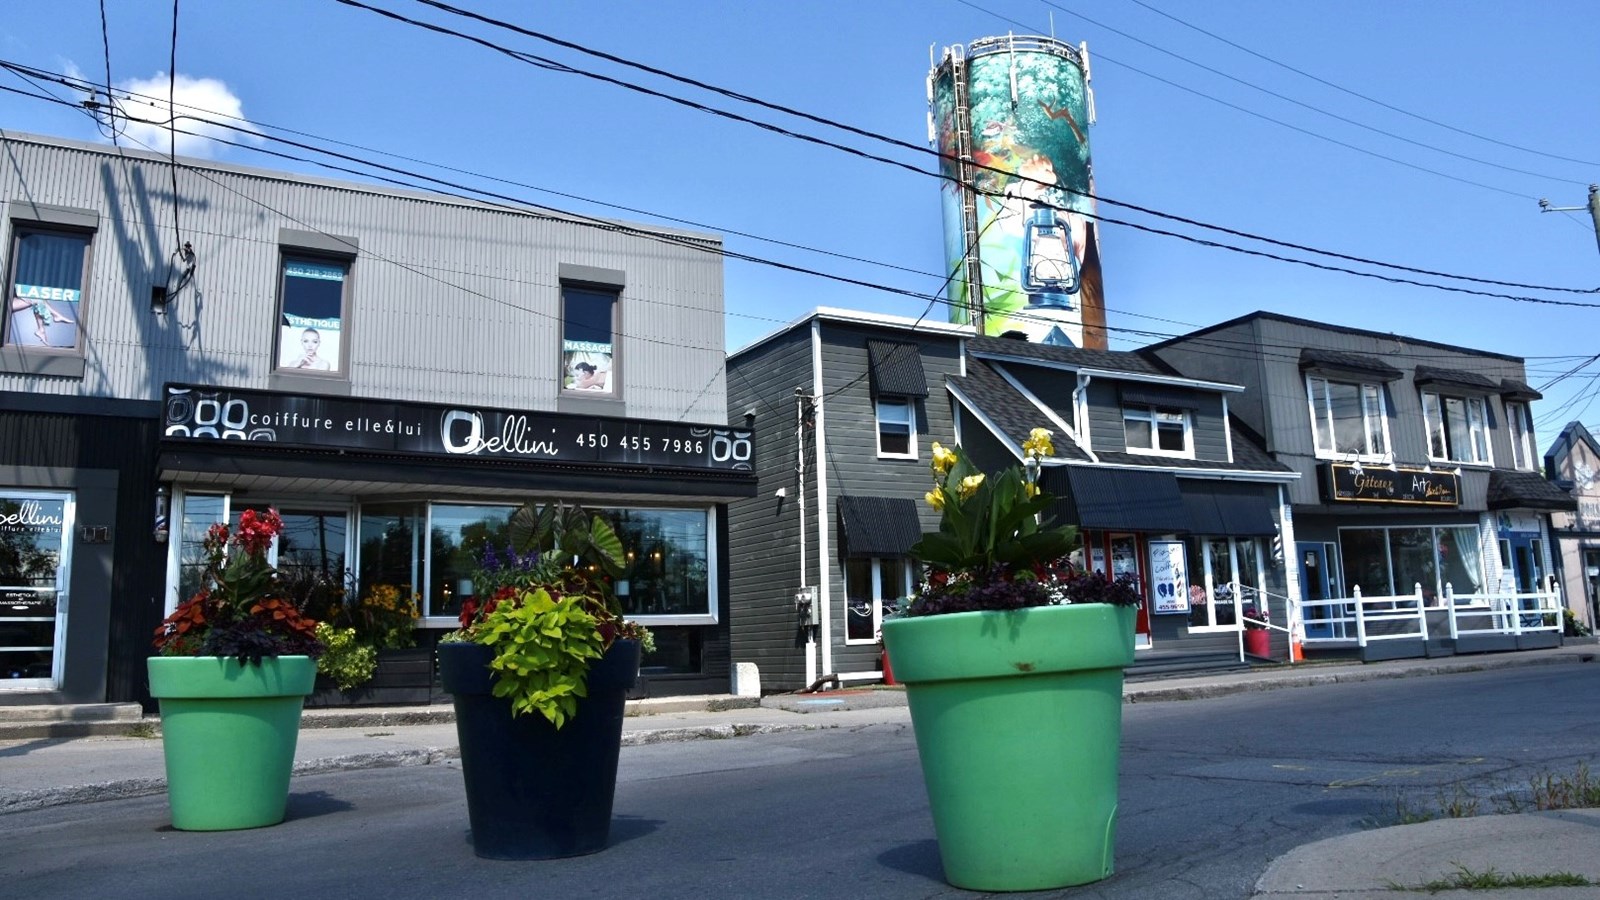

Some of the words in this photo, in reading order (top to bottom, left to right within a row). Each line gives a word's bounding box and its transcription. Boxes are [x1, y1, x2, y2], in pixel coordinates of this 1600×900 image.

[16, 285, 74, 302] LASER
[565, 341, 612, 353] MASSAGE
[250, 411, 332, 430] coiffure
[345, 419, 422, 436] elle&lui
[576, 433, 608, 448] 450
[619, 436, 651, 451] 455
[662, 438, 703, 454] 7986
